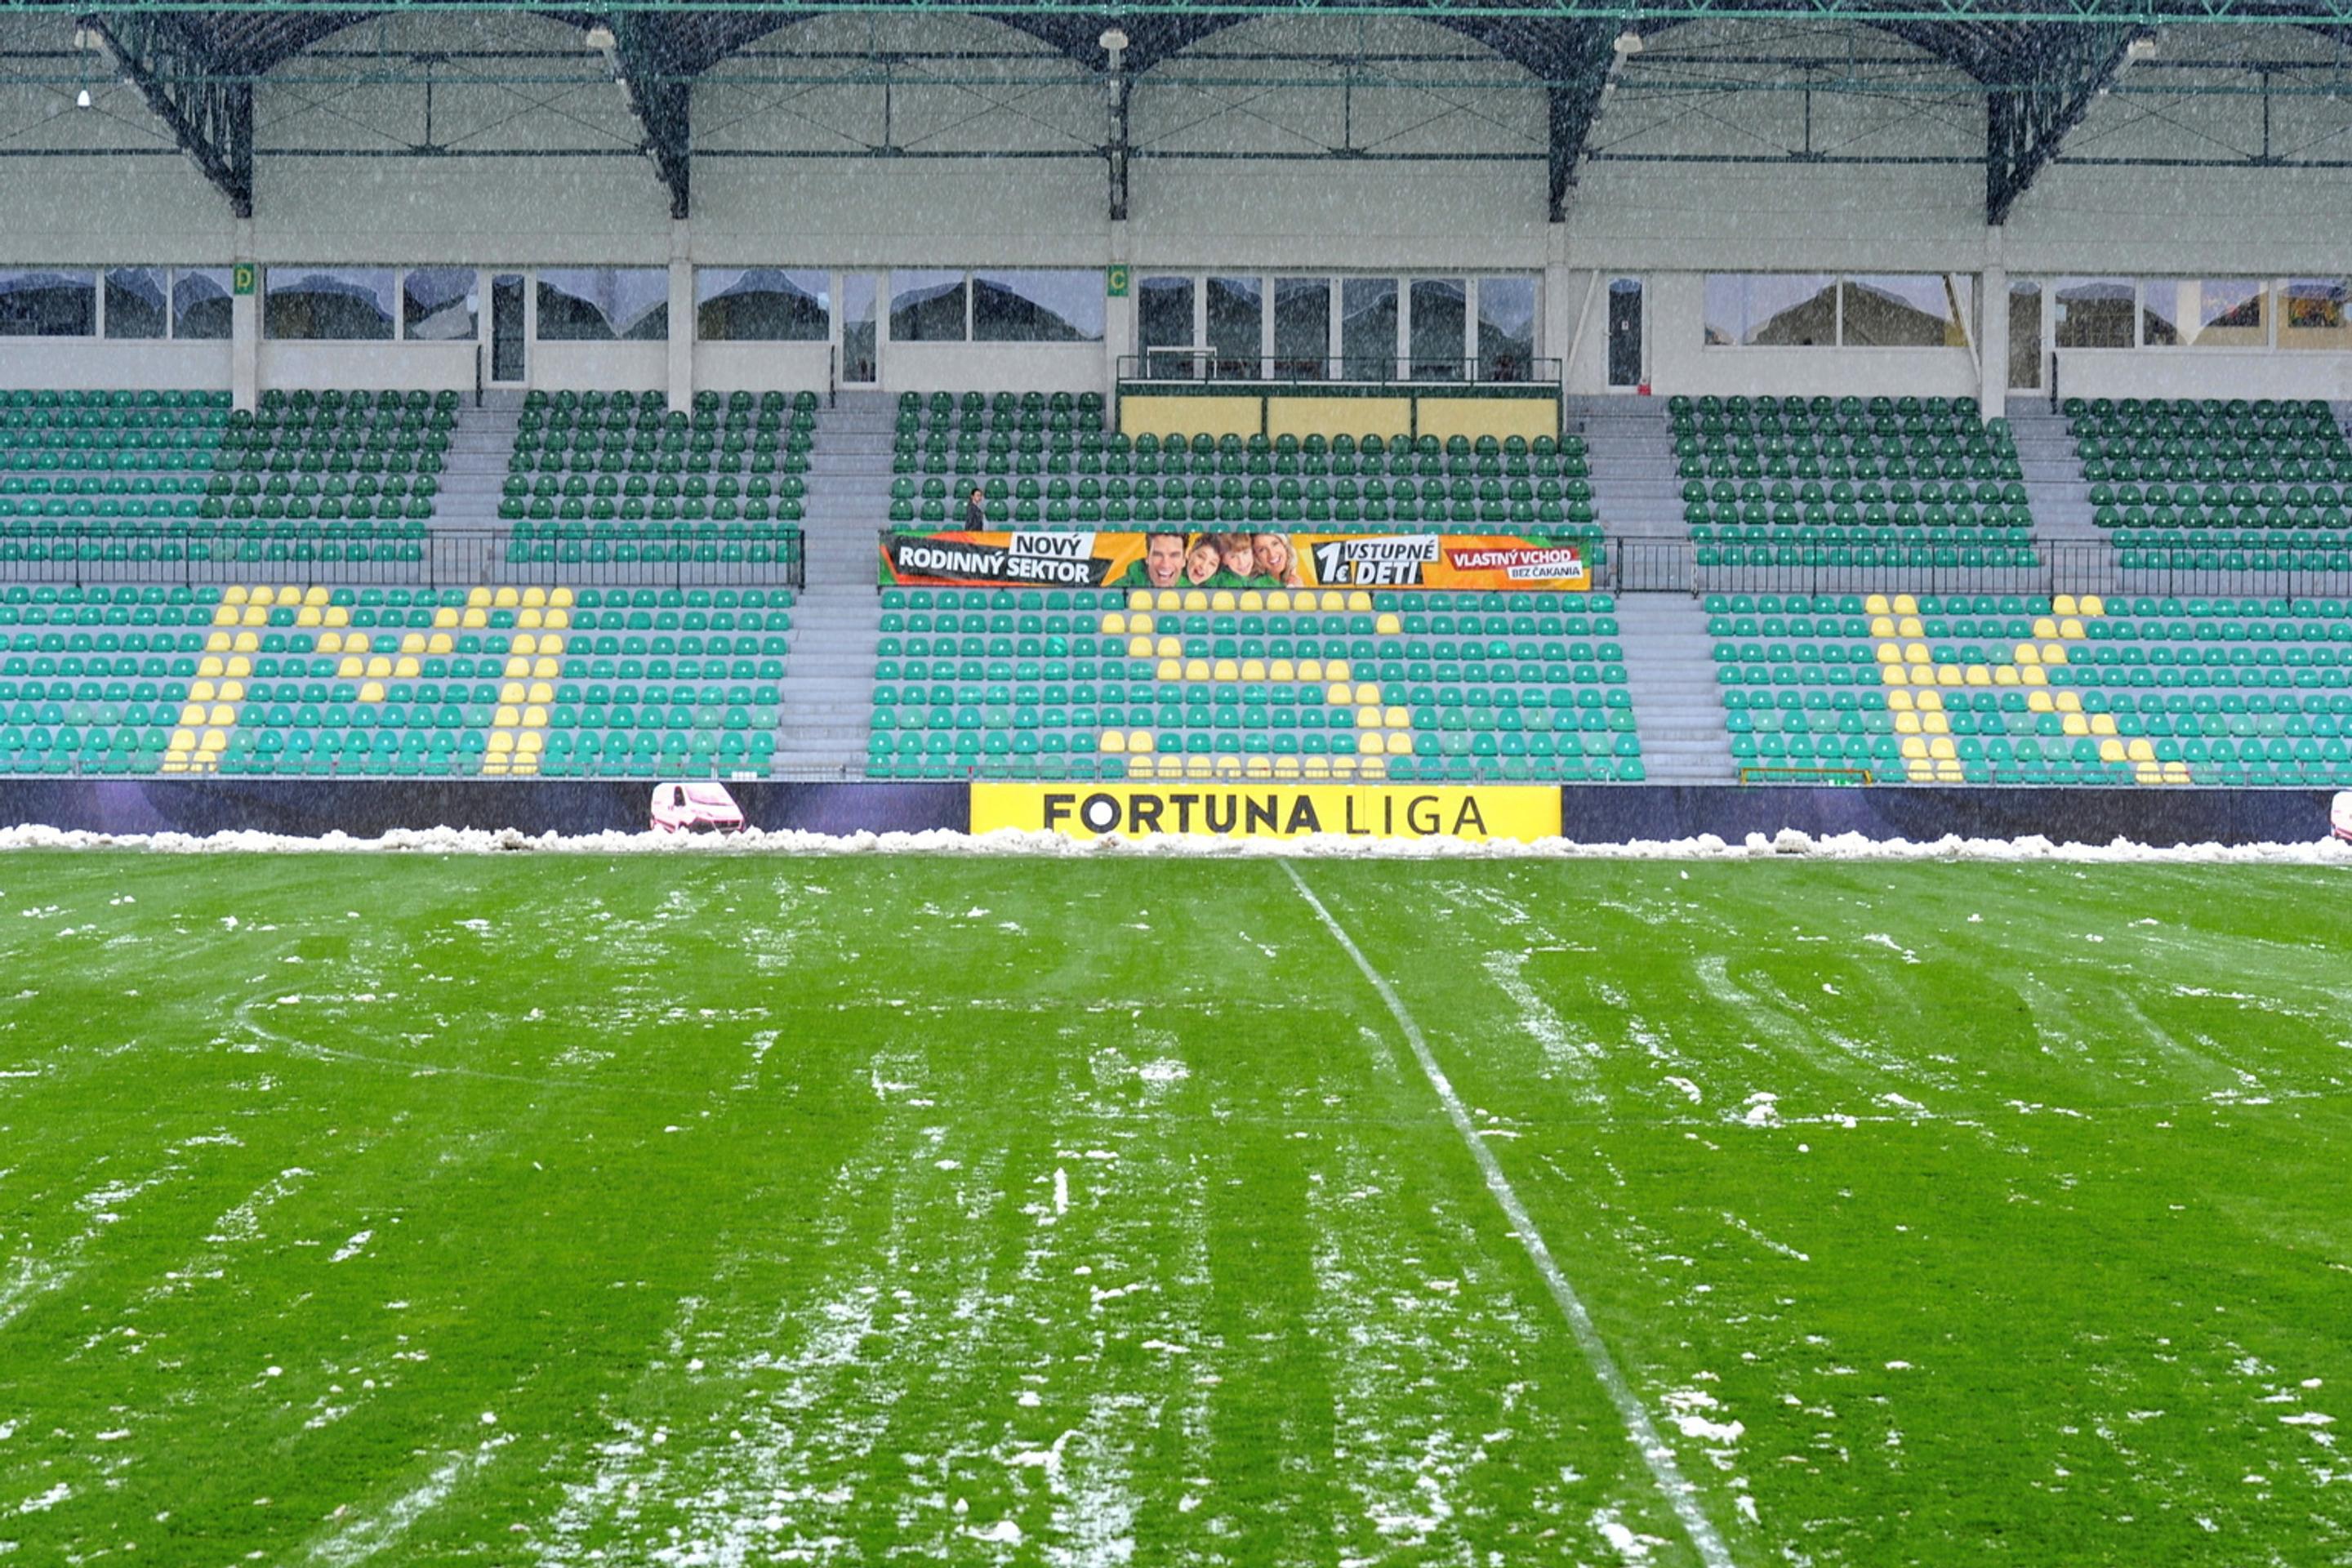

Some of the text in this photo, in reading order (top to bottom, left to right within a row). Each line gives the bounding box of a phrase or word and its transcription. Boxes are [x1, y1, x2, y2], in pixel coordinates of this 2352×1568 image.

[237, 269, 252, 287] D
[1111, 271, 1125, 289] C
[1015, 533, 1082, 556] NOVÝ
[1347, 539, 1436, 560] VSTUPNÉ
[898, 546, 1090, 583] RODINNÝ SEKTOR
[1454, 548, 1571, 567] VLASTNÝ VCHOD
[1355, 560, 1419, 585] DETI
[1512, 566, 1581, 577] BEZ ČAKANIA
[1042, 792, 1489, 835] FORTUNA LIGA
